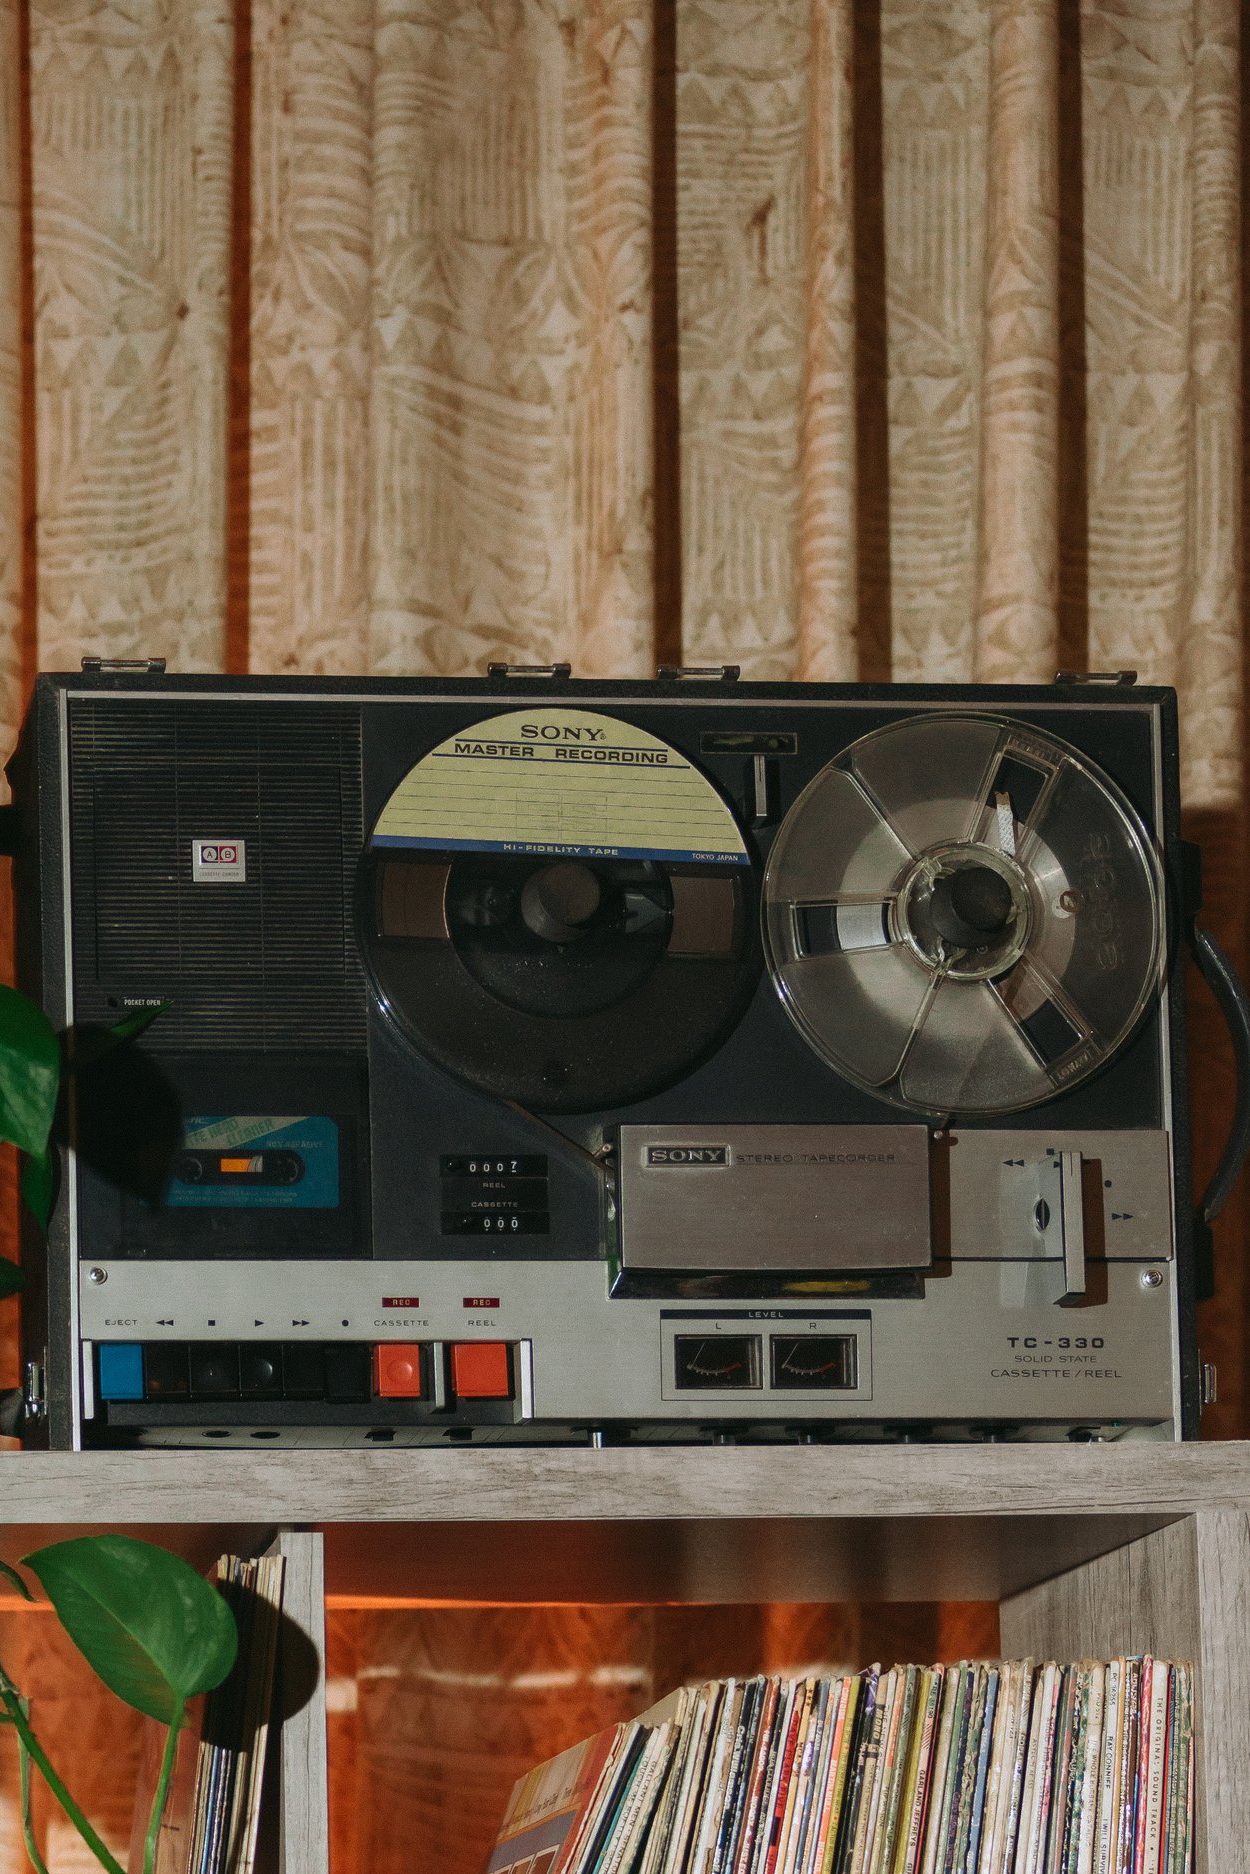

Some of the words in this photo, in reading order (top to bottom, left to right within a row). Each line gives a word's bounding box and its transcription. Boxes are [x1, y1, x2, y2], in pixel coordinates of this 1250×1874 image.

[521, 724, 602, 741] SONY
[454, 743, 535, 758] MASTER
[555, 748, 668, 764] RECORDING
[207, 850, 213, 859] A
[225, 850, 232, 859] B
[503, 843, 581, 855] HI-FIDELITY
[588, 847, 619, 856] TAPE
[692, 852, 715, 861] TOKYO
[716, 853, 739, 862] JAPAN
[651, 1149, 725, 1163] SONY
[736, 1154, 793, 1164] STEREO
[391, 1298, 412, 1307] REC
[472, 1298, 492, 1307] REC
[104, 1319, 138, 1327] EJECT
[373, 1319, 430, 1327] CASSETTE
[467, 1319, 497, 1327] REEL
[715, 1322, 722, 1330] L
[809, 1322, 817, 1330] R
[1006, 1337, 1106, 1350] TC-330
[1015, 1355, 1054, 1363] SOLID
[1058, 1355, 1097, 1363] STATE
[872, 1708, 883, 1740] MONO
[1153, 1718, 1162, 1764] ORIGINA
[1089, 1753, 1097, 1777] WHOLE
[1104, 1752, 1112, 1789] CONNIFF
[639, 1760, 658, 1803] GALLANT
[722, 1750, 741, 1809] Williamson
[1151, 1770, 1159, 1802] SOUND
[914, 1769, 925, 1806] GARLAND
[630, 1806, 641, 1826] MEN
[1149, 1808, 1157, 1838] TRACK
[909, 1807, 920, 1846] JEFFREYS
